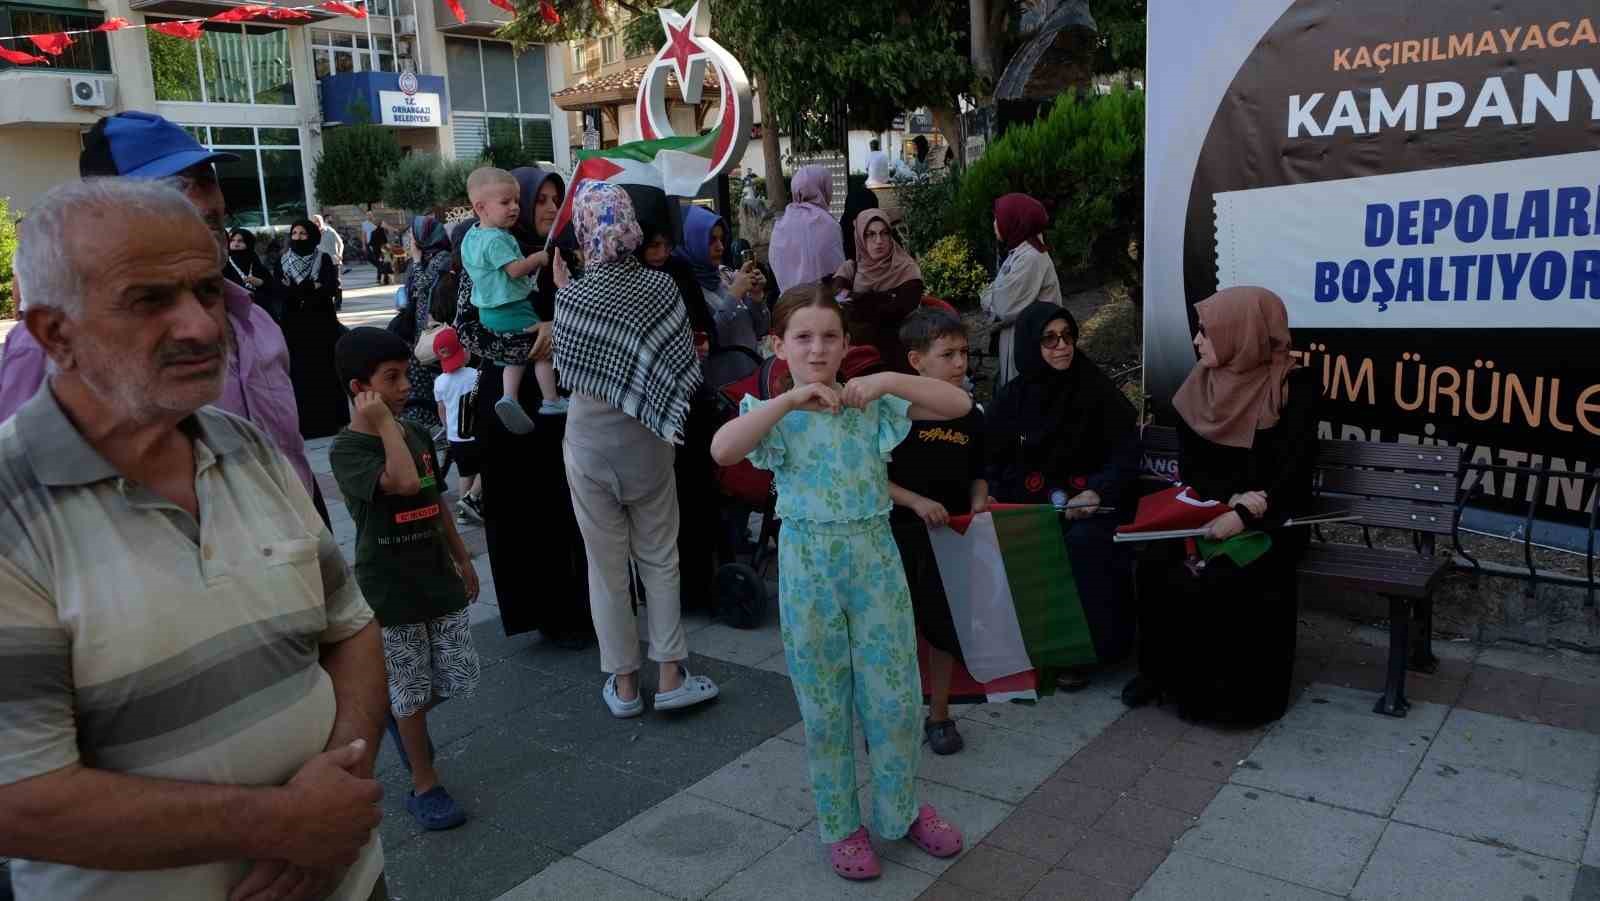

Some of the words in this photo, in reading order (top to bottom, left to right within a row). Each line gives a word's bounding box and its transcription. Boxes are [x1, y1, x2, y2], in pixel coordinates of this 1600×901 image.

[1333, 18, 1600, 73] KAÇIRILMAYACA
[1287, 68, 1600, 139] KAMPANY
[1314, 250, 1600, 312] BOŞALTIYOR
[1394, 352, 1600, 436] ÜRÜNLE
